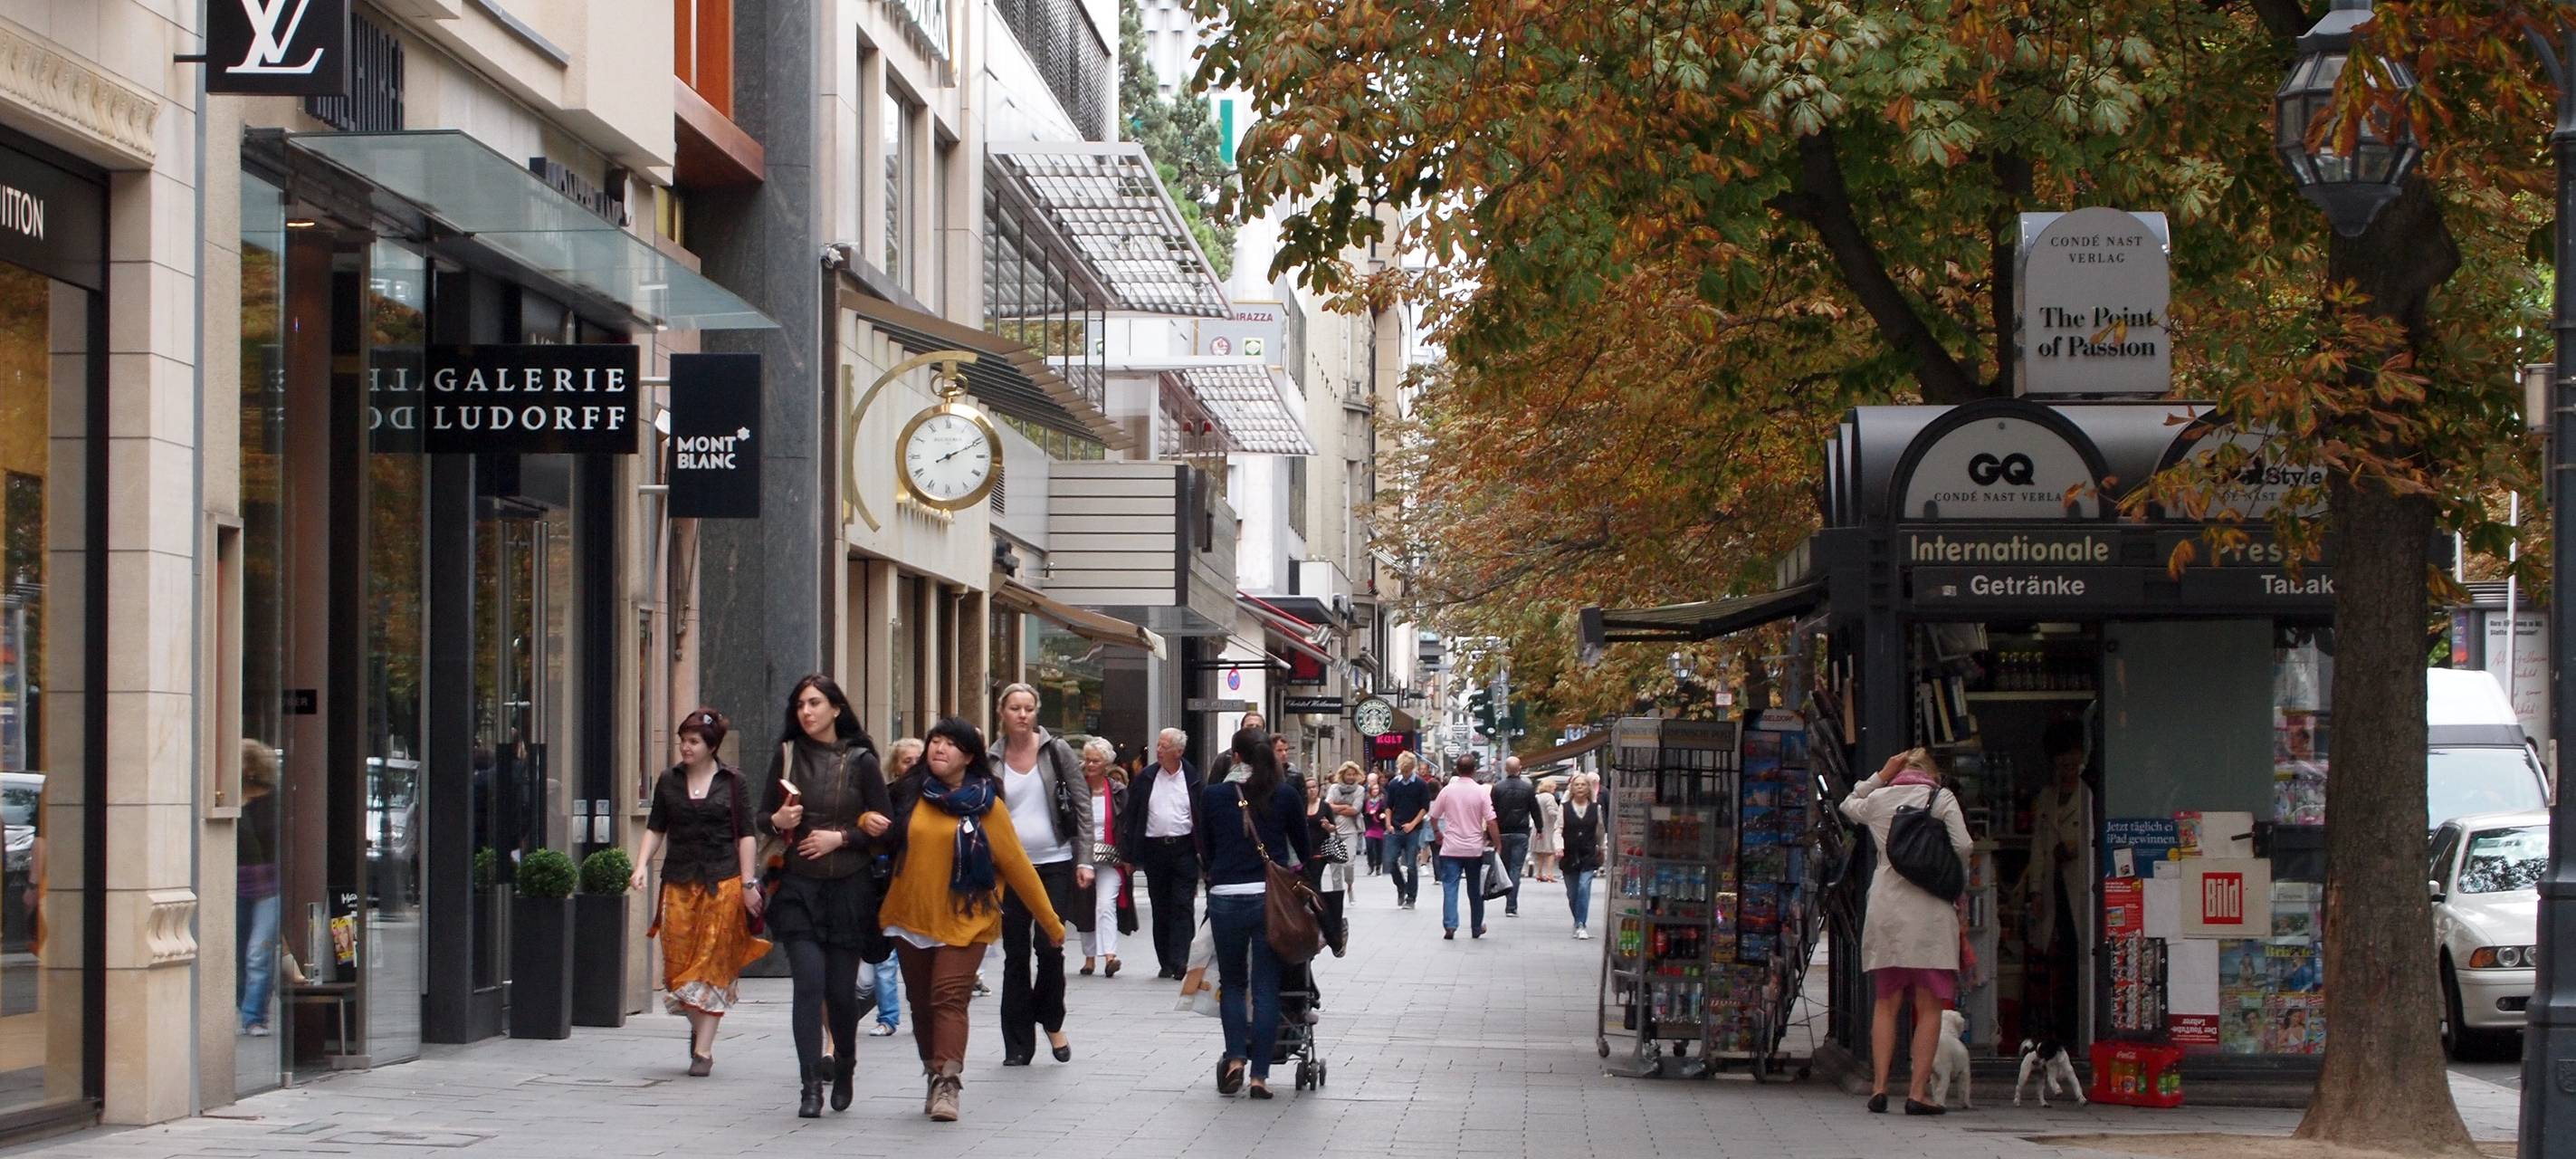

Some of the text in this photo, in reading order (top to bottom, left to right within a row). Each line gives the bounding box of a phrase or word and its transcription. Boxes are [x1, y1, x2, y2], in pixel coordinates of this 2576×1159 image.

[0, 183, 44, 242] ITTON
[2050, 235, 2143, 247] CONDÉ NAST
[2068, 254, 2125, 263] VERLAG
[2039, 306, 2157, 329] The Point
[2038, 336, 2156, 357] of Passion
[434, 368, 625, 392] GALERIE
[434, 406, 625, 431] LUDORFF
[677, 436, 737, 452] MONT
[677, 453, 737, 469] BLANC
[1968, 453, 2035, 486] GQ
[1933, 491, 2063, 502] CONDÉ NAST VERLA
[1911, 534, 2109, 562] Internationale
[1970, 574, 2085, 596] Getränke
[2107, 820, 2174, 834] Jetzt täglich ei
[2107, 833, 2178, 845] iPad gewinnen.
[2206, 878, 2240, 918] Bild
